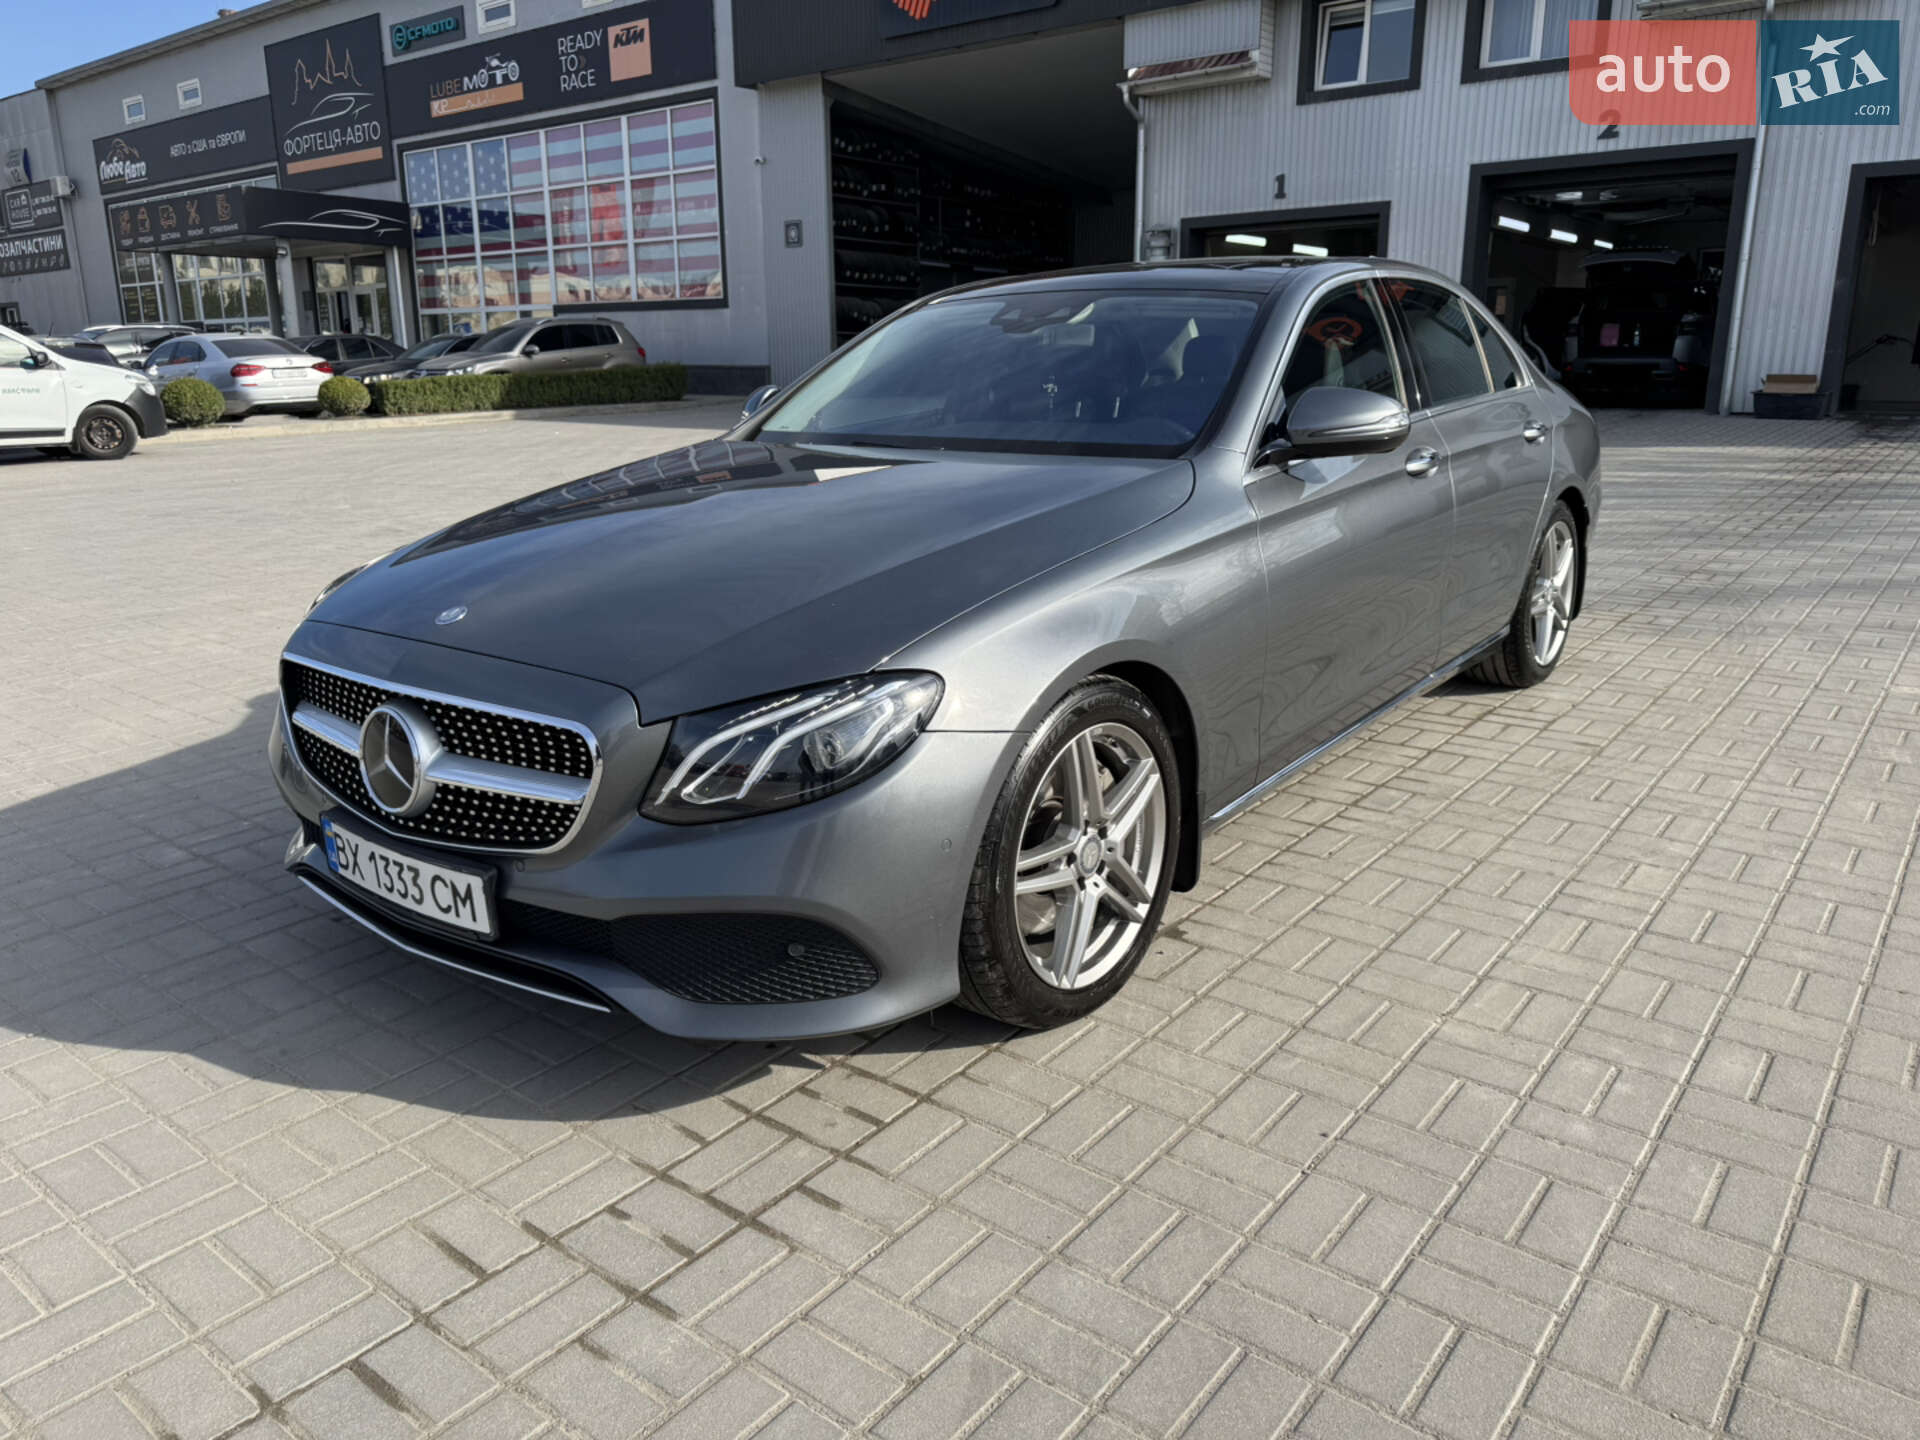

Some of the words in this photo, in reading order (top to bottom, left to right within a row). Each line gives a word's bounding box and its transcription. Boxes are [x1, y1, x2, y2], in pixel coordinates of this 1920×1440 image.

[407, 17, 457, 40] CFMOTO
[613, 25, 645, 48] KTM
[557, 29, 603, 54] READY
[559, 55, 578, 73] TO
[560, 69, 597, 92] RACE
[1597, 109, 1621, 140] 2
[283, 121, 381, 156] ФОРТЕЦЯ-АВТО
[1274, 173, 1286, 199] 1
[335, 834, 365, 881] BX
[368, 851, 424, 905] 1333
[430, 874, 477, 922] CM
